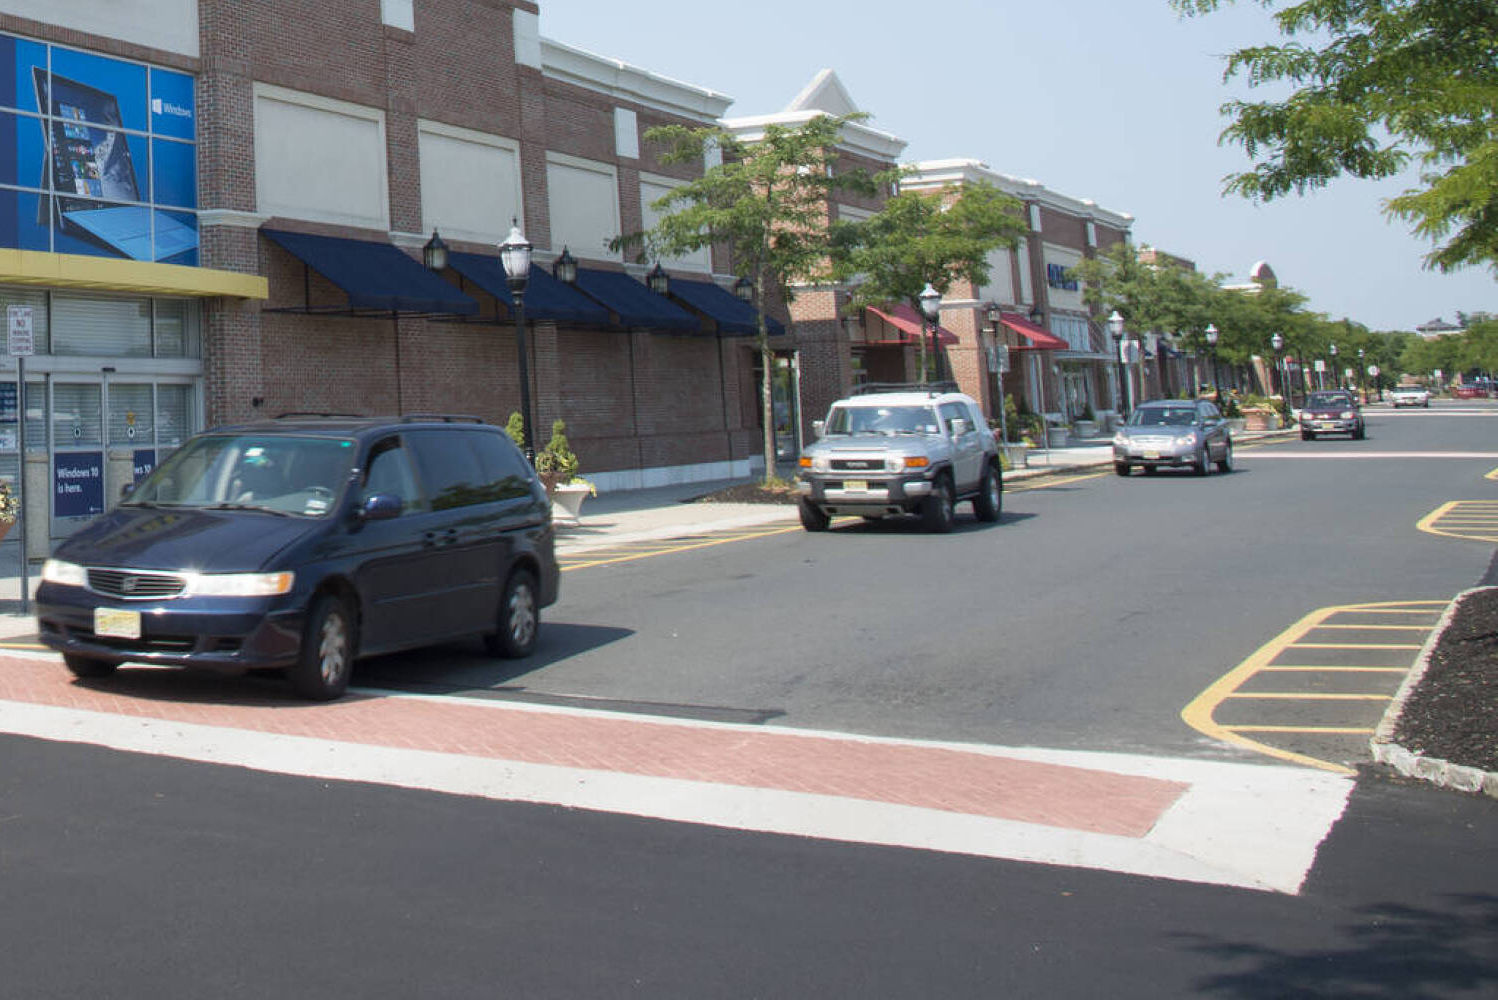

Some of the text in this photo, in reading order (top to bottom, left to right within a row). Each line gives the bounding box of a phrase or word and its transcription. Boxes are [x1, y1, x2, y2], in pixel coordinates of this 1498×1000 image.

[57, 466, 99, 478] Windows 10
[57, 483, 82, 494] is here.
